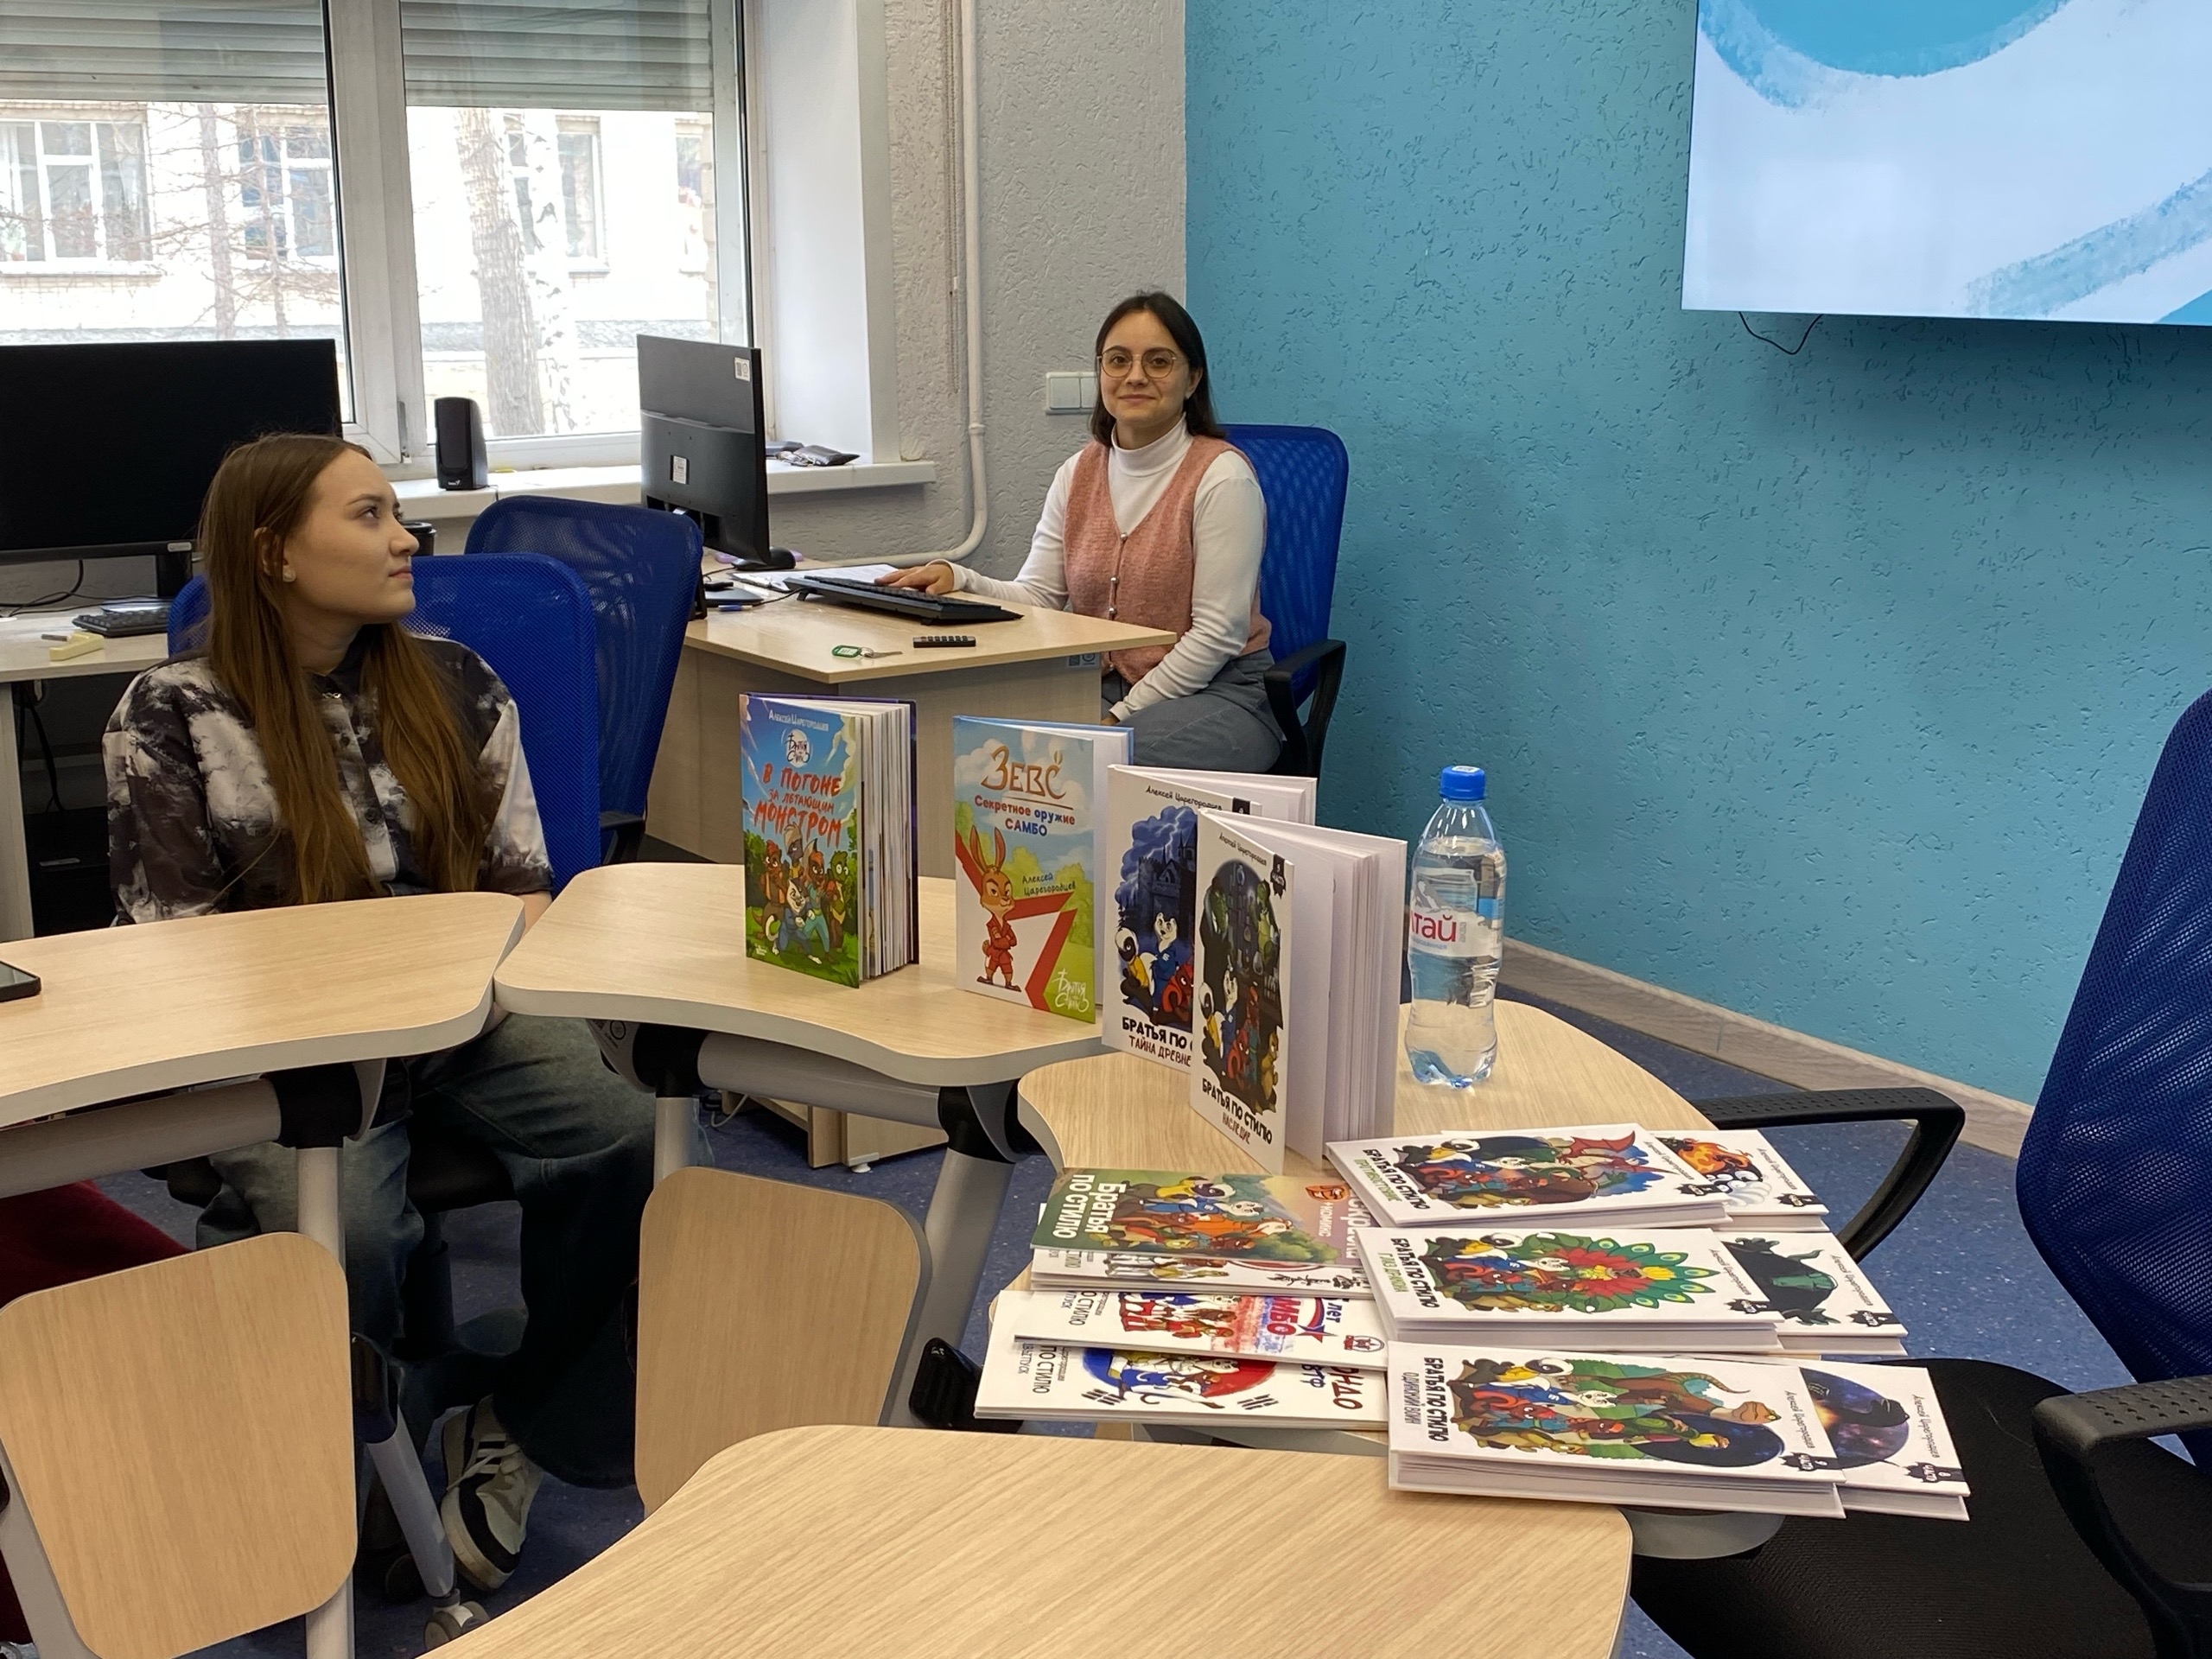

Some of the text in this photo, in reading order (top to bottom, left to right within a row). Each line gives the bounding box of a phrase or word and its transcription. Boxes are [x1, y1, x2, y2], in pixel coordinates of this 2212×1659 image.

[762, 763, 842, 797] В ПОГОНЕ
[1146, 785, 1173, 800] Алексей
[781, 792, 835, 815] ЛЕТАЮЩИМ
[974, 794, 1076, 825] Секретное оружие
[753, 798, 842, 849] МОНСТРОМ
[1004, 817, 1048, 837] САМБО
[1022, 872, 1054, 884] Алексей
[1023, 880, 1077, 897] Царегородцев
[1122, 1016, 1167, 1044] БРАТЬЯ
[1168, 1032, 1187, 1050] ПО
[1128, 1034, 1192, 1067] ТАЙНА ДРЕВНЕ
[1202, 1077, 1273, 1145] БРАТЬЯ ПО СТИЛЮ
[1222, 1112, 1251, 1145] НАСЛЕДИЕ
[1363, 1148, 1431, 1210] БРАТЬЯ ПО СТИЛЮ
[1052, 1174, 1096, 1239] ПО СТИЛЮ
[1084, 1182, 1127, 1234] Братья
[1377, 1252, 1398, 1268] ГЛАЗ
[1390, 1237, 1440, 1308] БРАТЬЯ ПО СТИЛЮ
[1068, 1298, 1095, 1325] СТИЛЮ
[1325, 1302, 1343, 1324] лет
[1032, 1361, 1055, 1394] СТИЛЮ
[1423, 1357, 1450, 1442] БРАТЬЯ ПО СТИЛЮ
